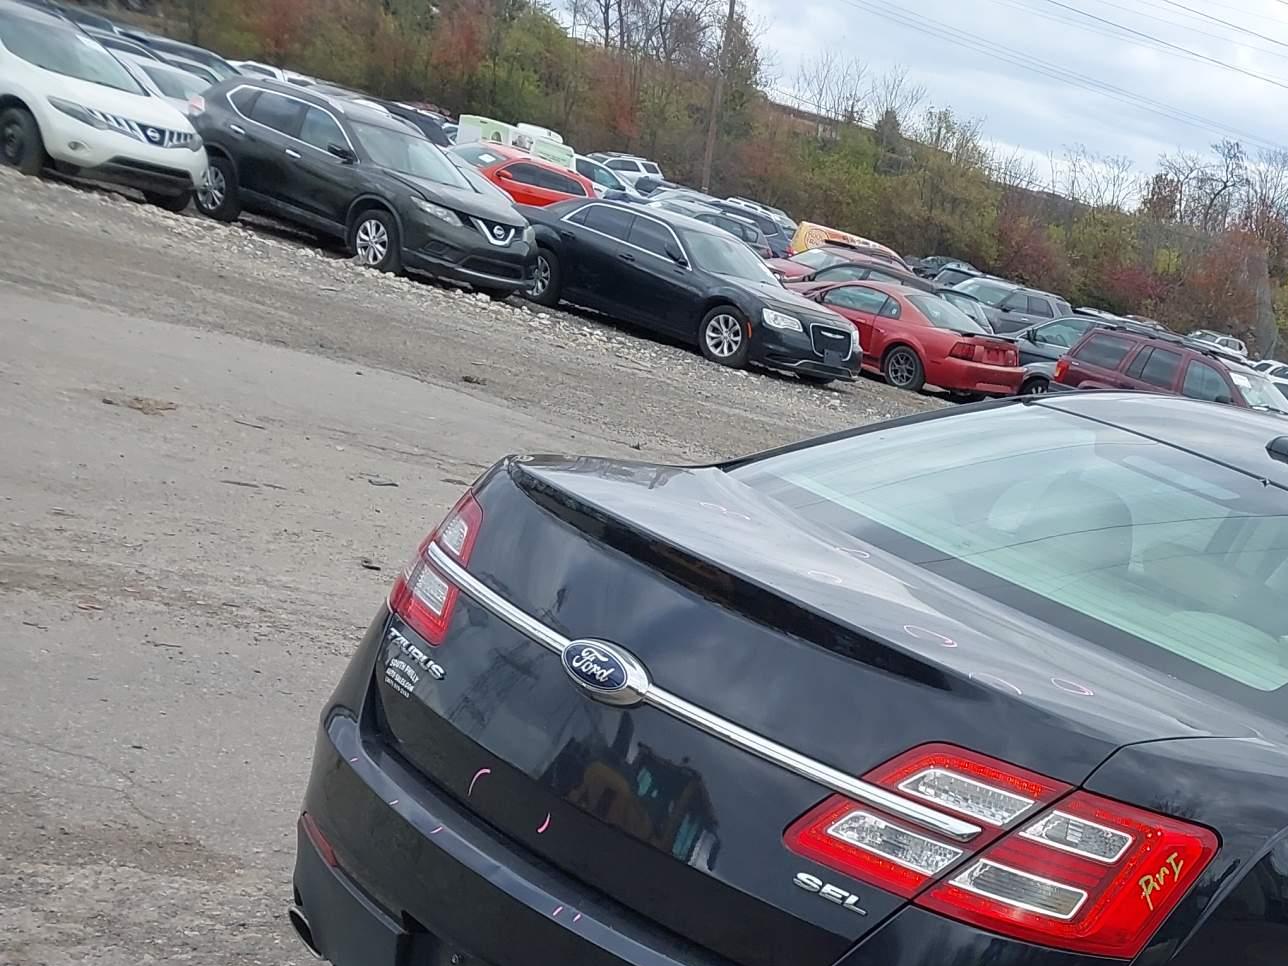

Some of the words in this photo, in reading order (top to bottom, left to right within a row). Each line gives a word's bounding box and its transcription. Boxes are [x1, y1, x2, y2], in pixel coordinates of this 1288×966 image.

[388, 626, 447, 680] TAURUS
[572, 647, 616, 682] Ford
[793, 872, 867, 916] SEL
